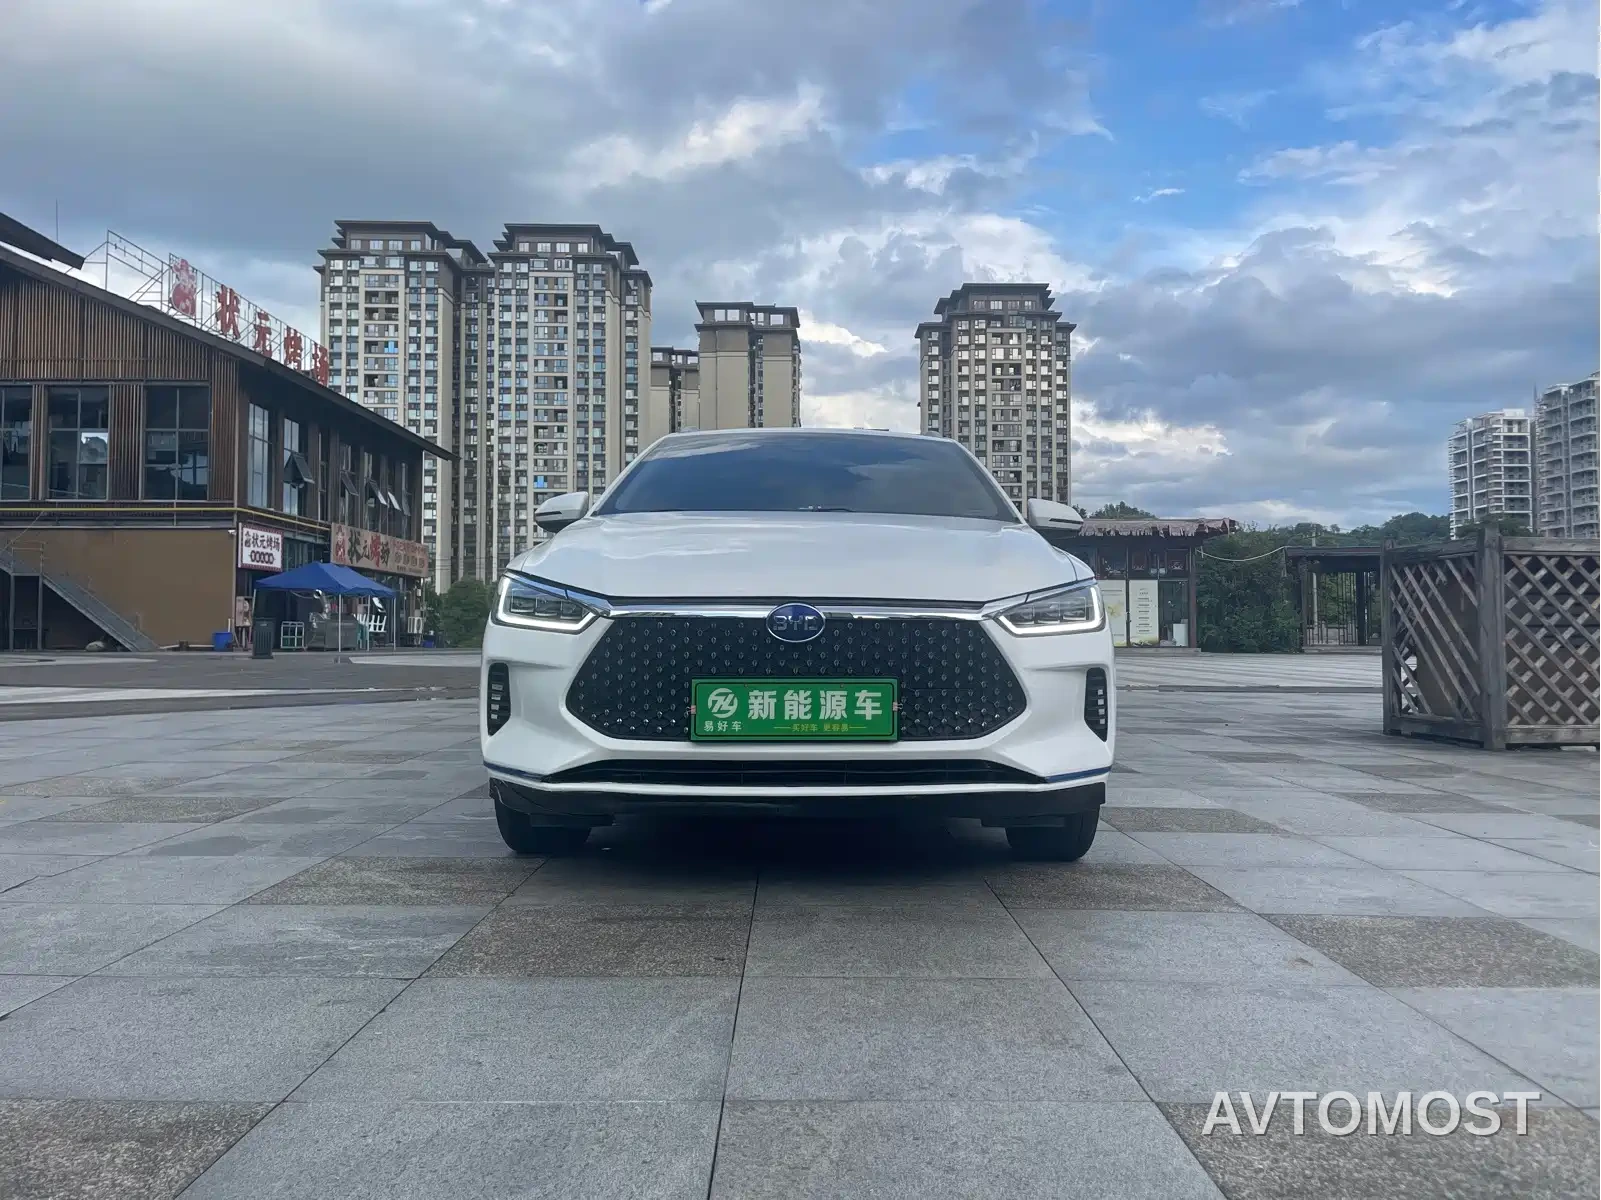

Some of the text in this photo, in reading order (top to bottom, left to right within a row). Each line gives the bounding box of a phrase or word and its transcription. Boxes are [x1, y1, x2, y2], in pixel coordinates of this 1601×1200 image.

[216, 284, 329, 387] 状元烤场
[252, 532, 280, 551] 状元烤场
[773, 615, 819, 631] BYD
[748, 690, 883, 720] 新能源车
[704, 720, 742, 732] 易好车
[792, 723, 849, 732] 买好车 更容易
